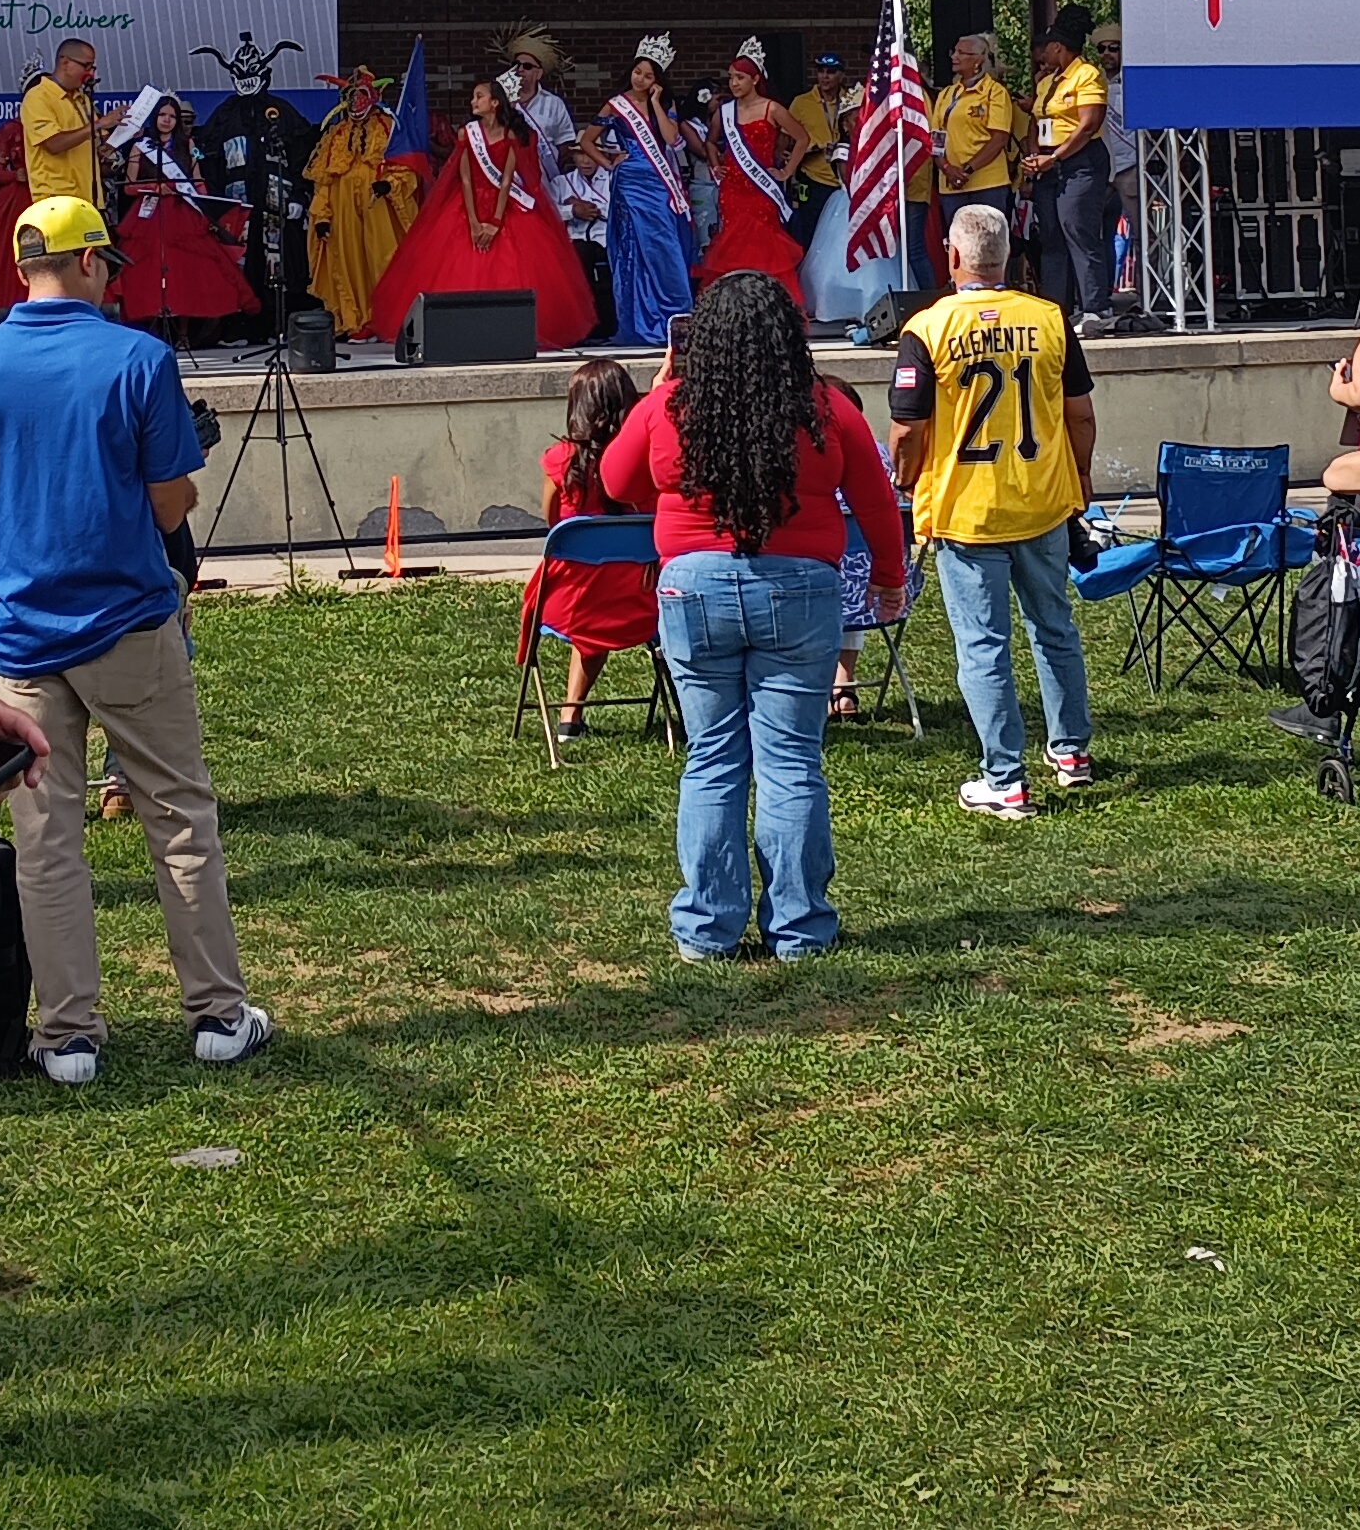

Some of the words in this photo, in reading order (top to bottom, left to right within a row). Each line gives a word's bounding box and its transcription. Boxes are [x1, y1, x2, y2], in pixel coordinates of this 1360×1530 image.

[26, 2, 135, 34] Delivers
[948, 326, 1039, 361] CLEMENTE
[956, 356, 1040, 465] 21
